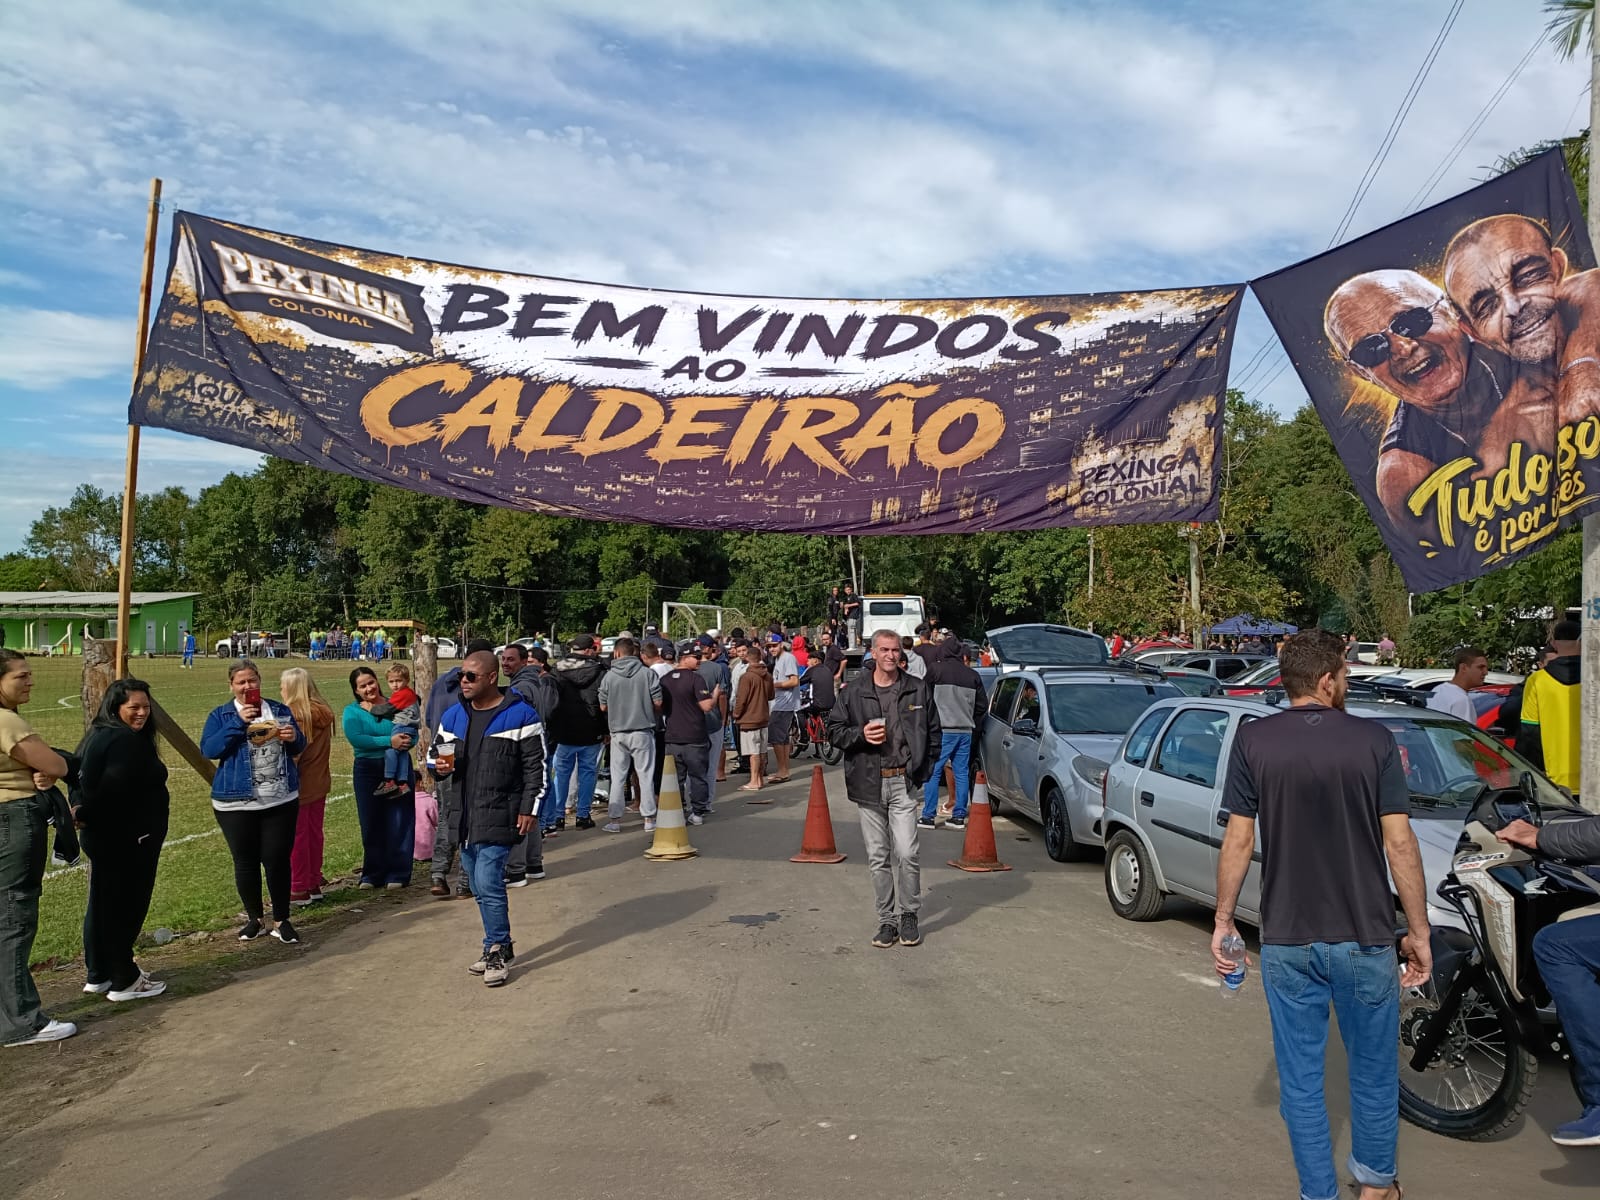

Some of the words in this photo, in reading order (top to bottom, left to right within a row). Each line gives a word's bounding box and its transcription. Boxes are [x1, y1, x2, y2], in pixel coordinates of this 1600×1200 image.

[211, 241, 414, 334] PEXINGA
[268, 298, 374, 329] COLONIAL
[435, 283, 668, 354] BEM
[696, 305, 1071, 363] VINDOS
[661, 356, 747, 382] AO
[360, 360, 1006, 482] CALDEIRÃO
[1080, 474, 1205, 506] COLONIAL
[1407, 443, 1553, 547] Tudo
[1558, 416, 1600, 471] so
[1474, 520, 1494, 552] é
[1501, 503, 1546, 553] por
